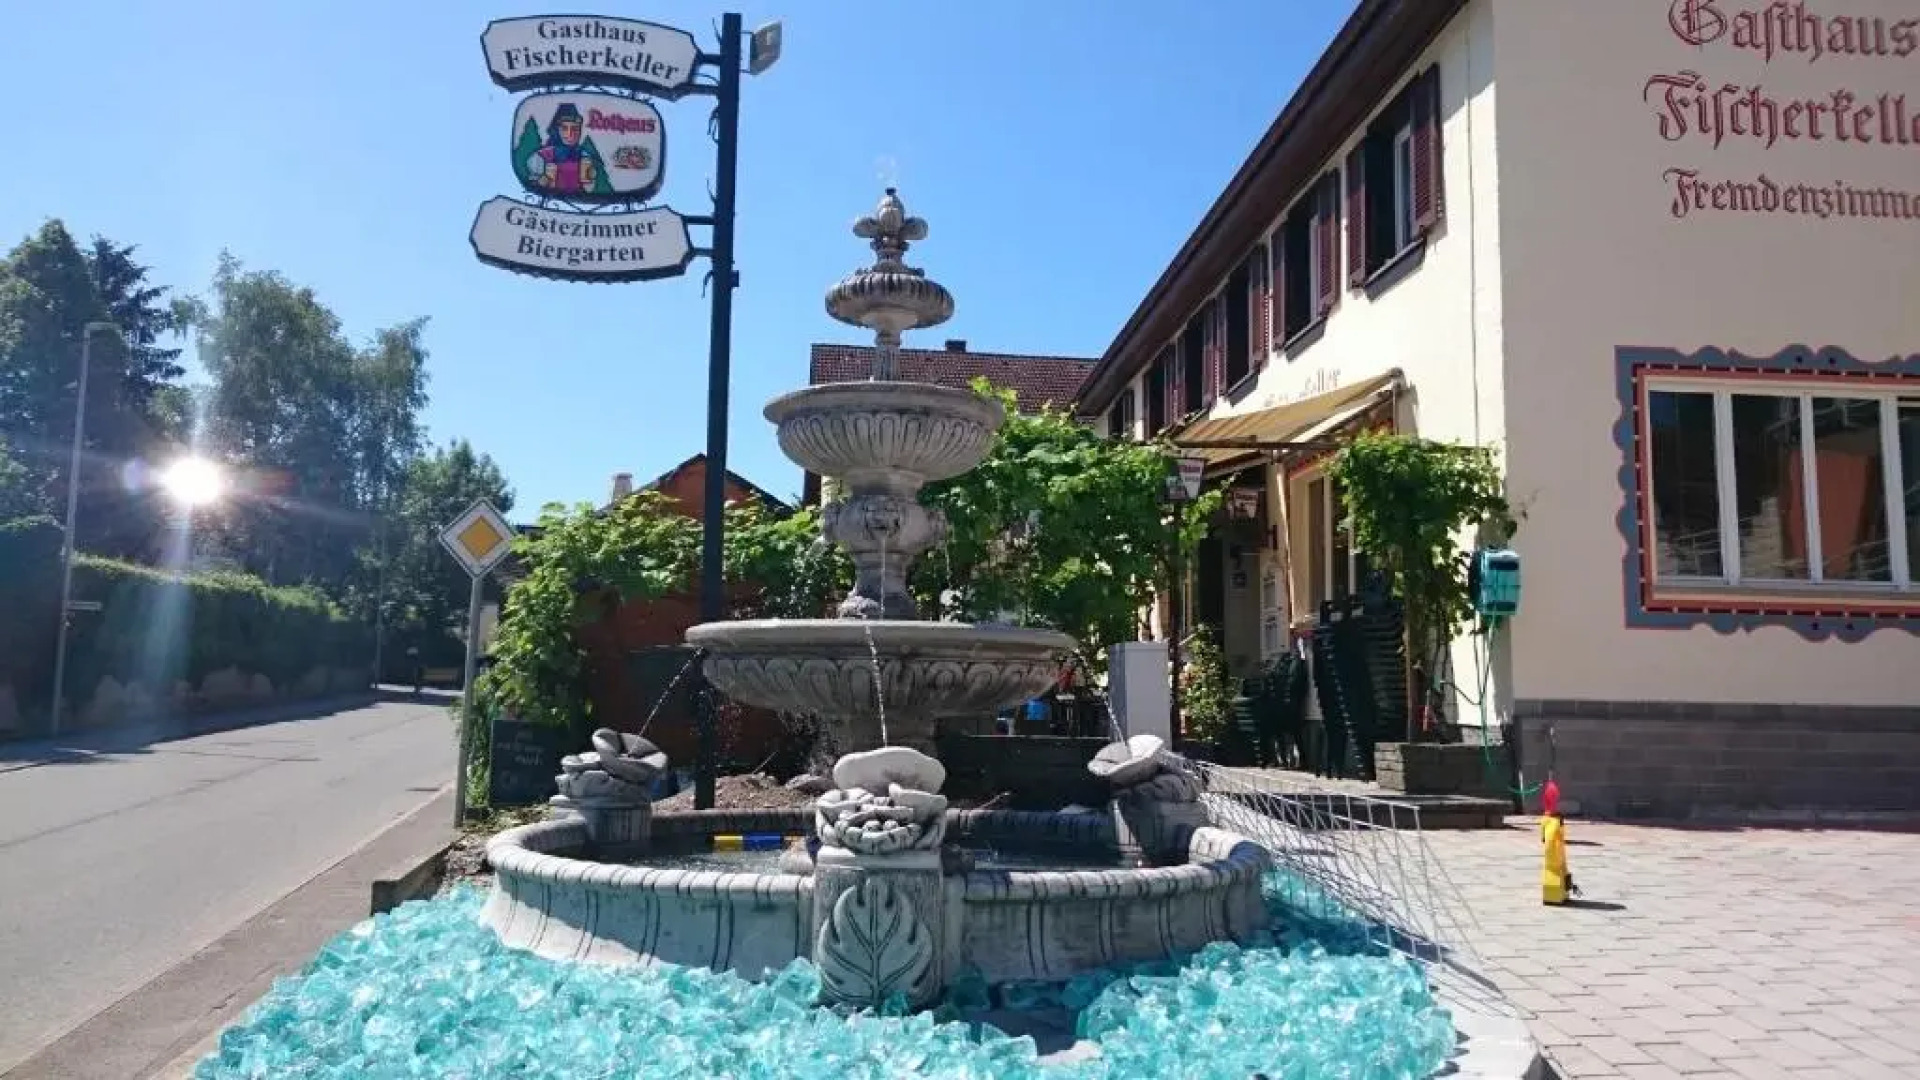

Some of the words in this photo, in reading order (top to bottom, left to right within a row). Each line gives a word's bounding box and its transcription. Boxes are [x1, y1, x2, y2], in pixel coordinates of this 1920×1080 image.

[537, 20, 648, 45] Gasthaus
[503, 45, 680, 80] Fischerkeller
[585, 107, 657, 135] Rothaus
[505, 206, 658, 238] Gästezimmer
[517, 236, 645, 266] Biergarten
